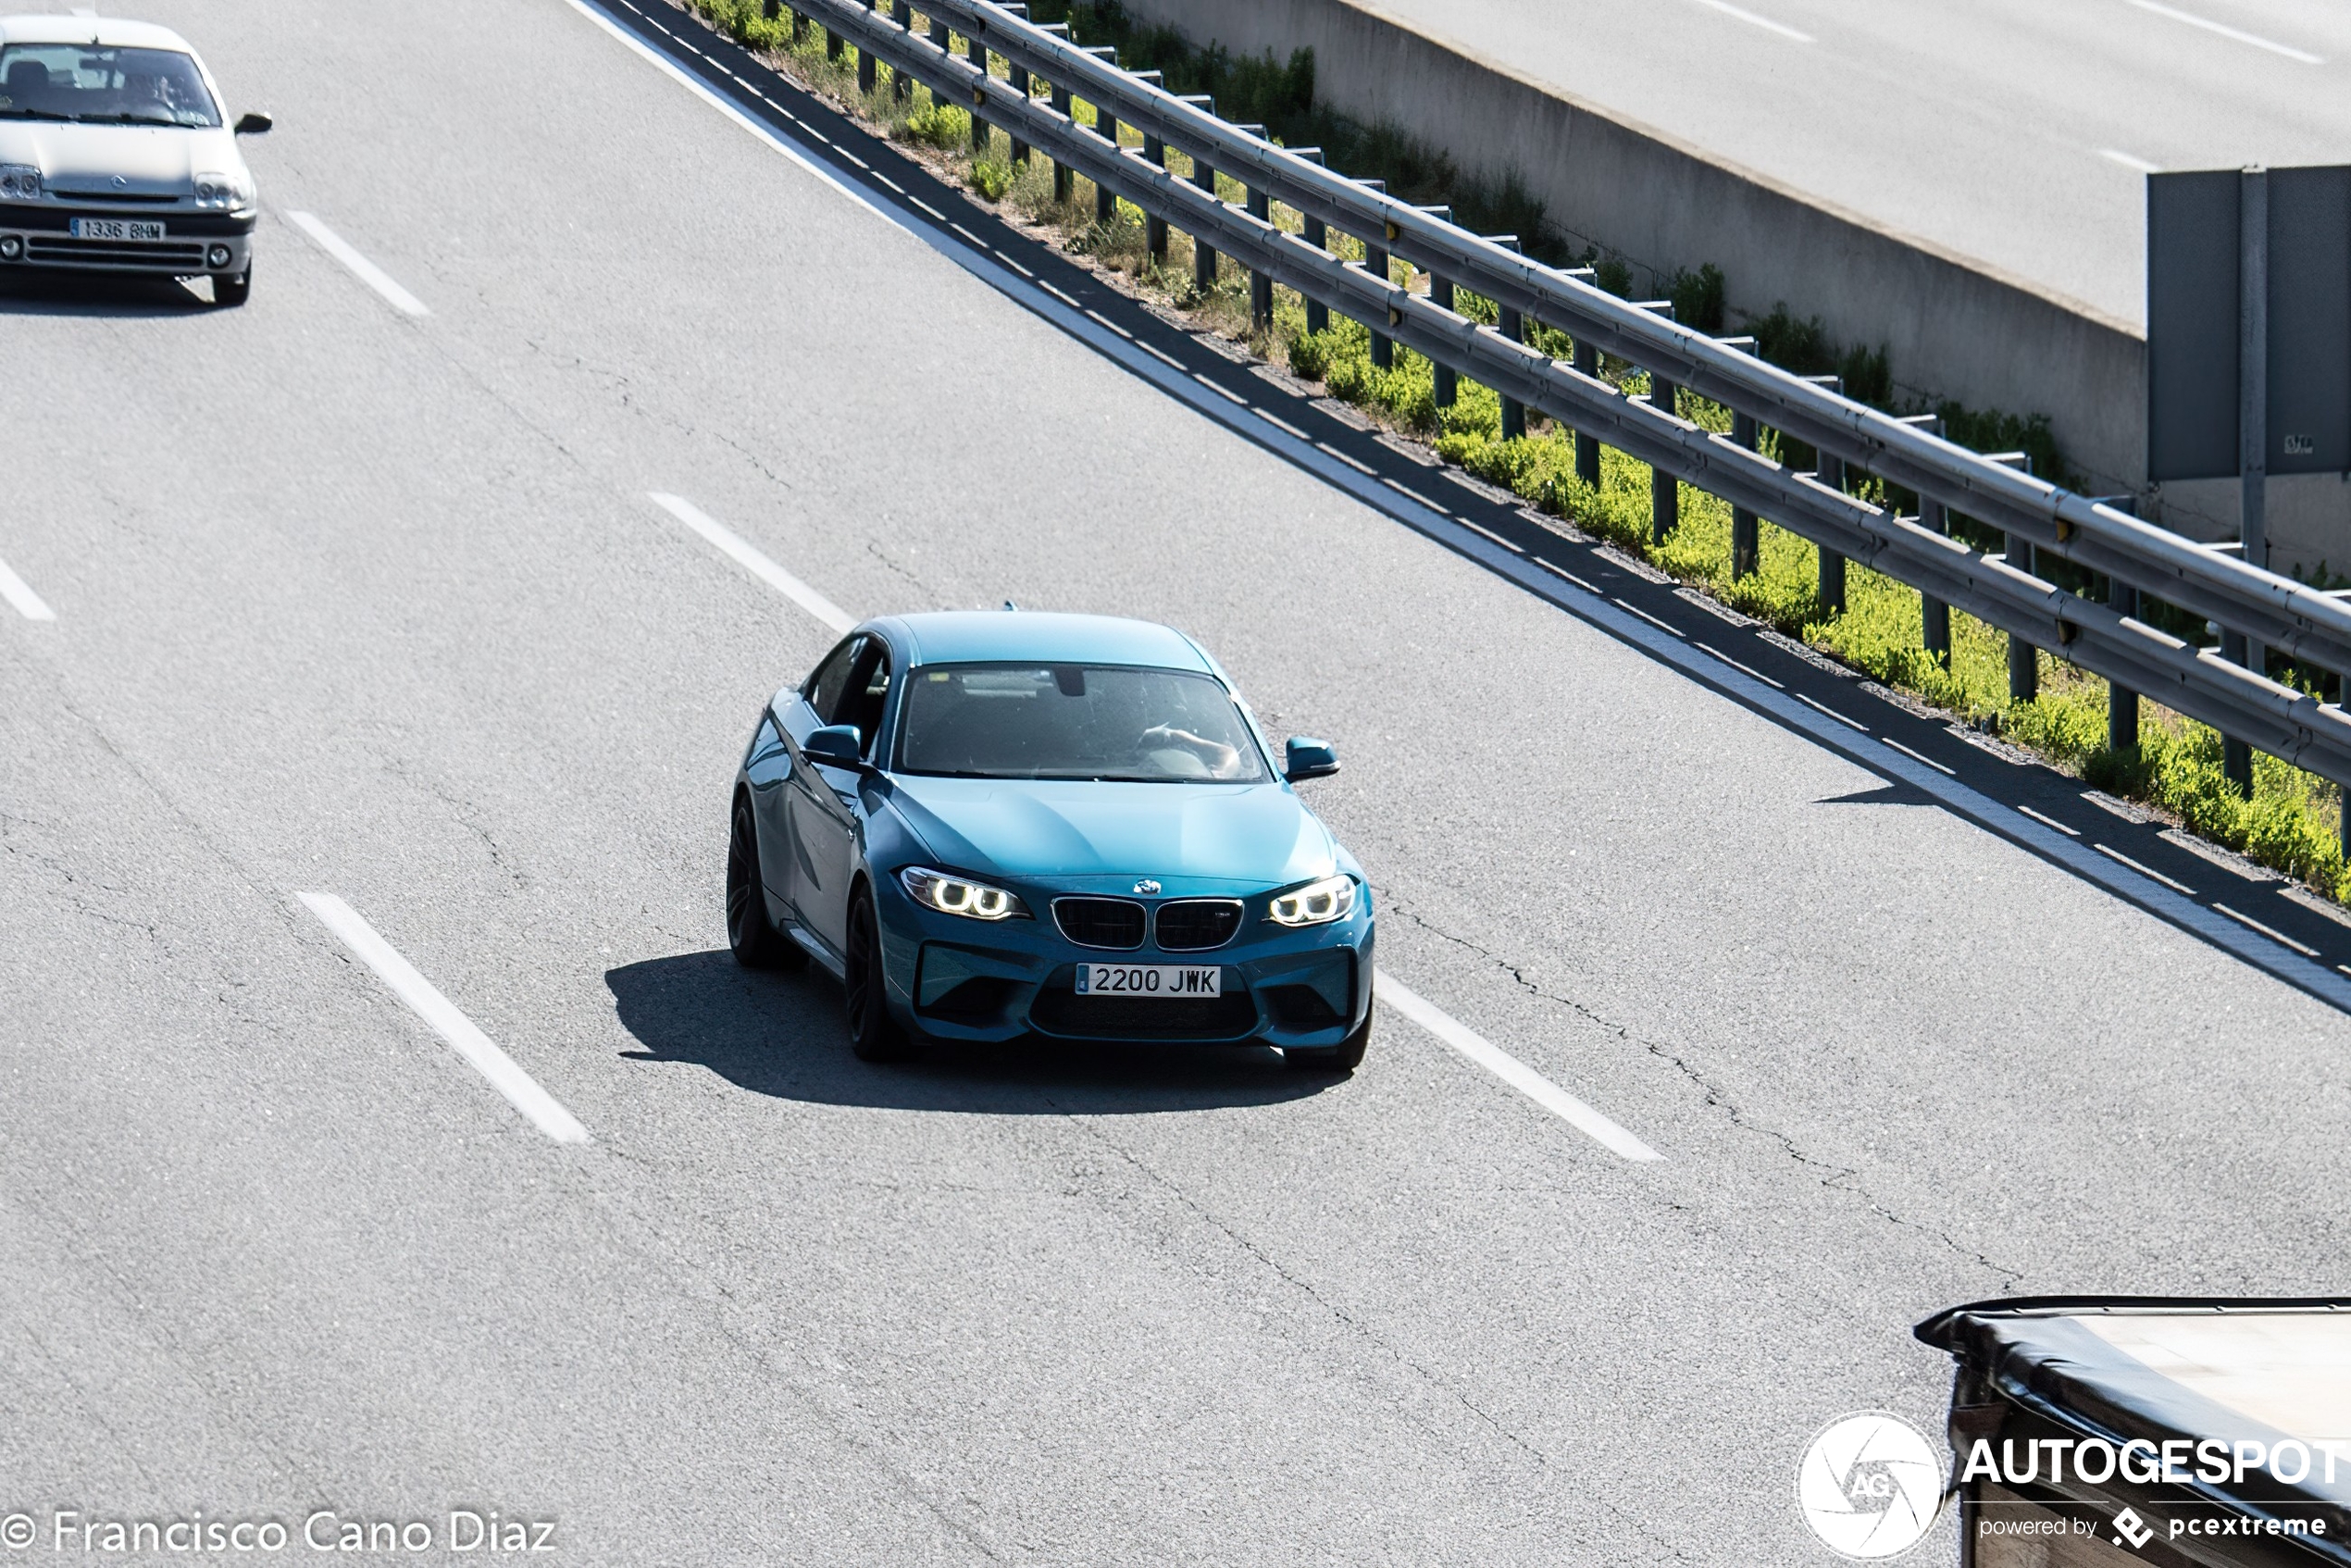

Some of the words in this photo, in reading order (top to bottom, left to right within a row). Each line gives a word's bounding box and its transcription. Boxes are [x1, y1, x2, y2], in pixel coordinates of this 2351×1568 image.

[86, 221, 123, 238] 1336
[1095, 968, 1160, 991] 2200
[1169, 970, 1215, 993] JWK
